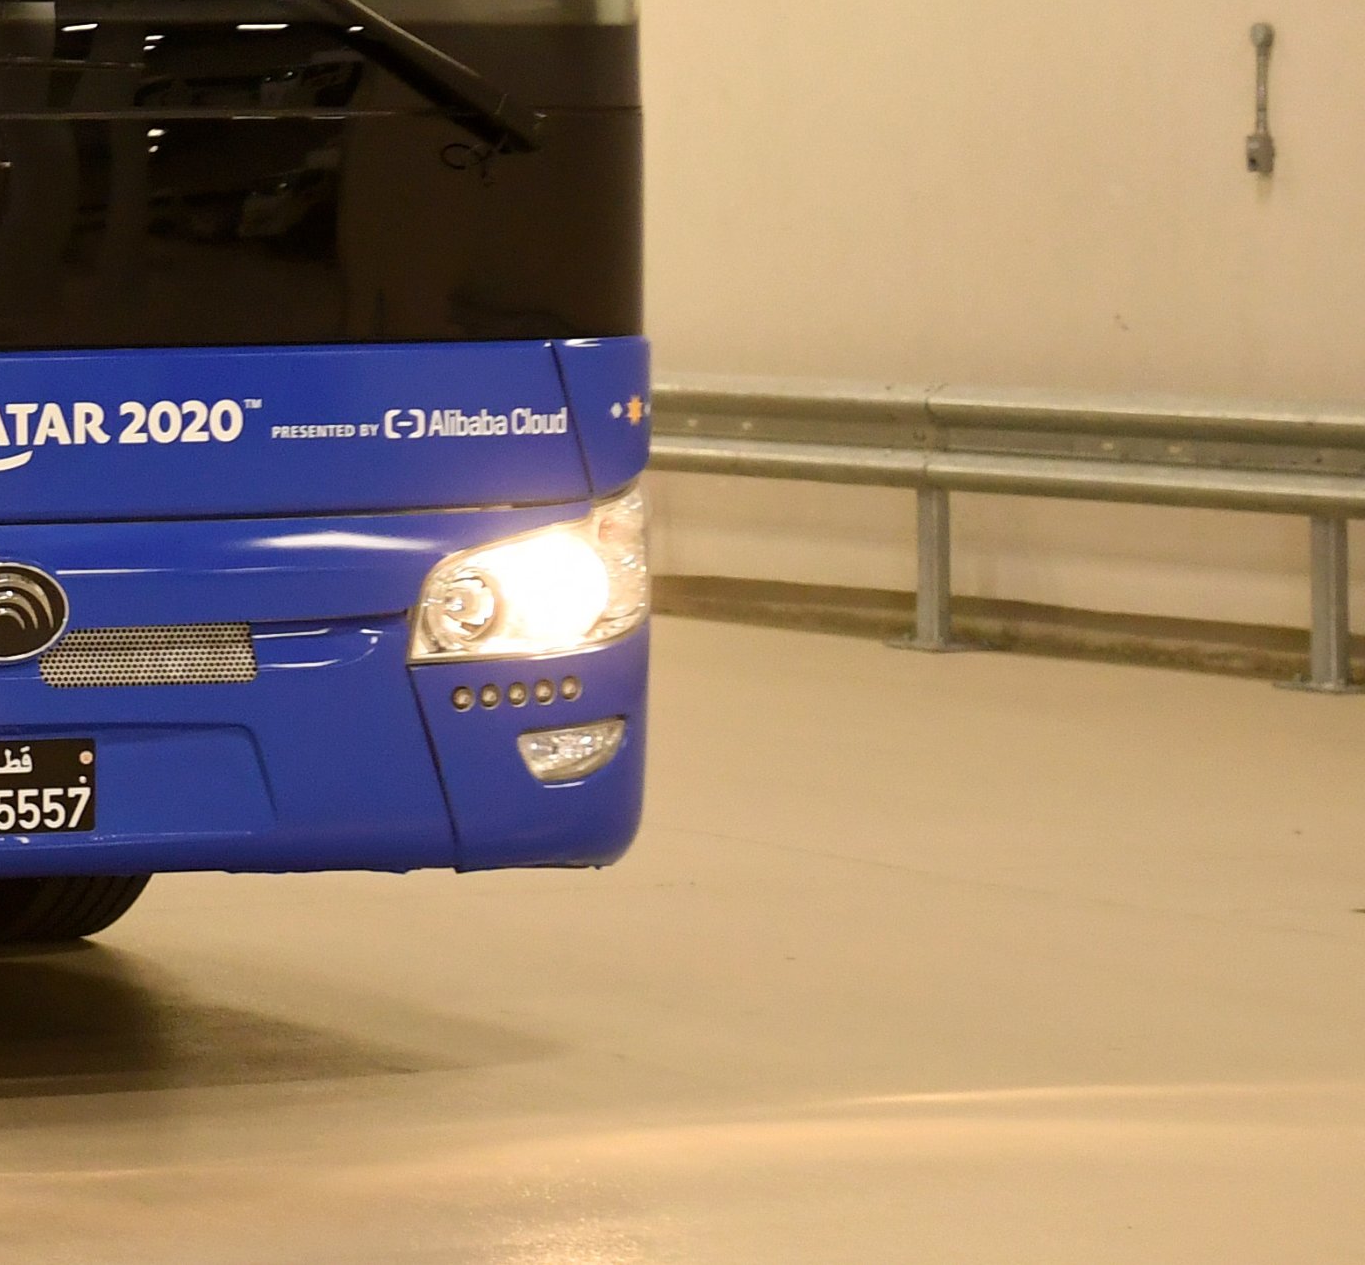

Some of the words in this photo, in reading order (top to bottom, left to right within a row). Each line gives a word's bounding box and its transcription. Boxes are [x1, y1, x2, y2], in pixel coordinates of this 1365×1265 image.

[271, 424, 355, 439] PRESENTED
[359, 423, 379, 437] BY
[428, 408, 508, 437] Alibaba
[511, 406, 568, 434] Cloud
